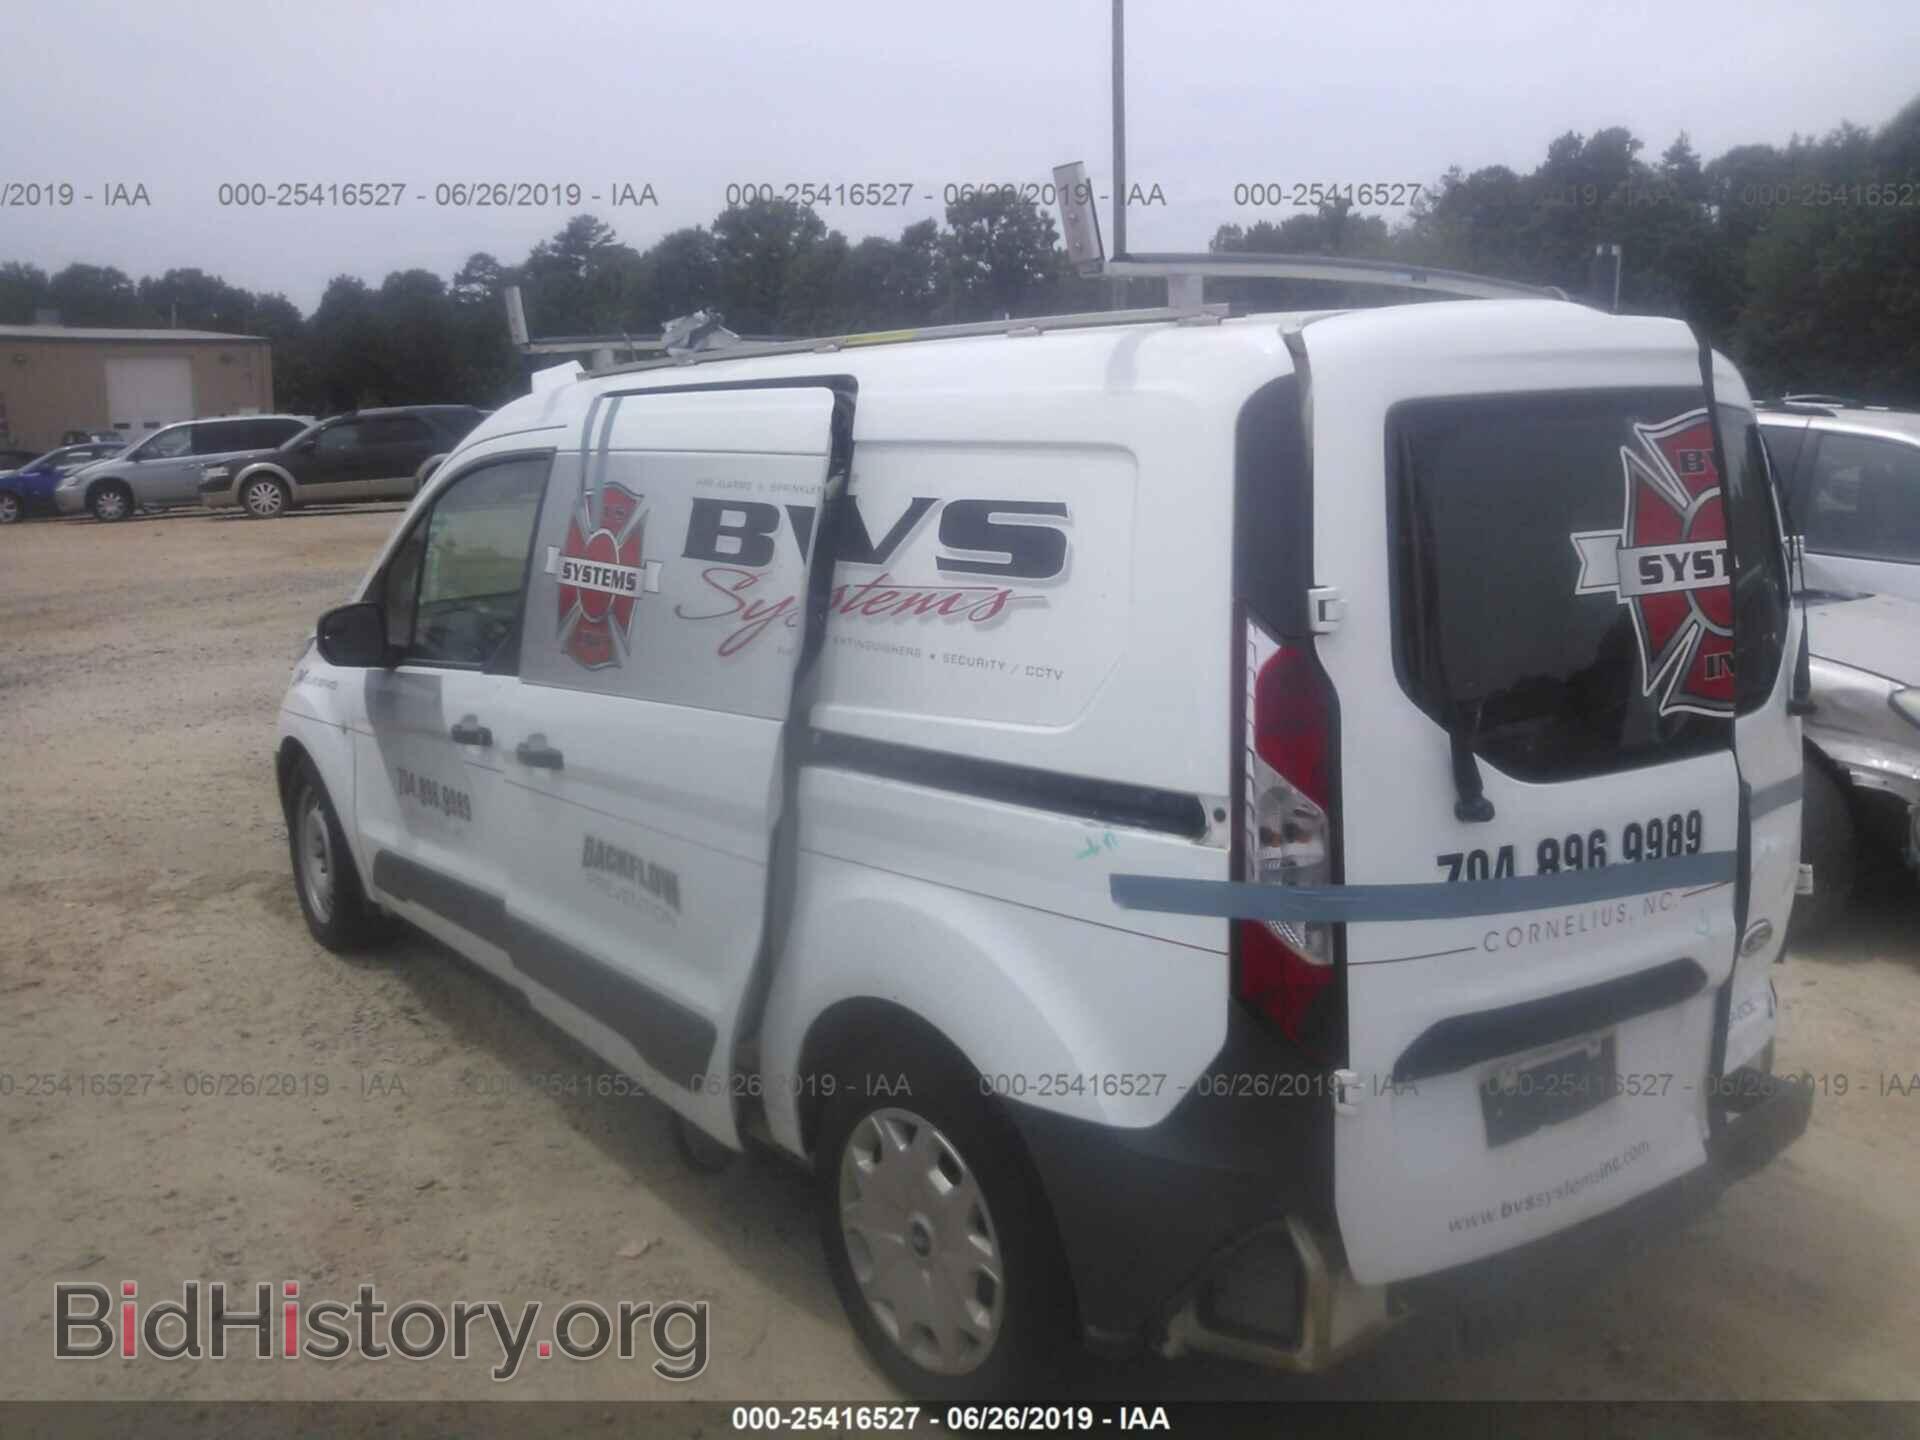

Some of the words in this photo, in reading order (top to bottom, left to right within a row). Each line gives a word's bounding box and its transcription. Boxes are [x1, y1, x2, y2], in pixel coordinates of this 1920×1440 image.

[562, 561, 637, 592] SYSTEMS
[942, 653, 1005, 673] SECURITY
[1025, 664, 1064, 681] CCTV
[1436, 845, 1515, 883] 704
[1536, 828, 1608, 876] 896
[1622, 809, 1703, 864] 9989
[1483, 903, 1634, 952] CORNELIUS,
